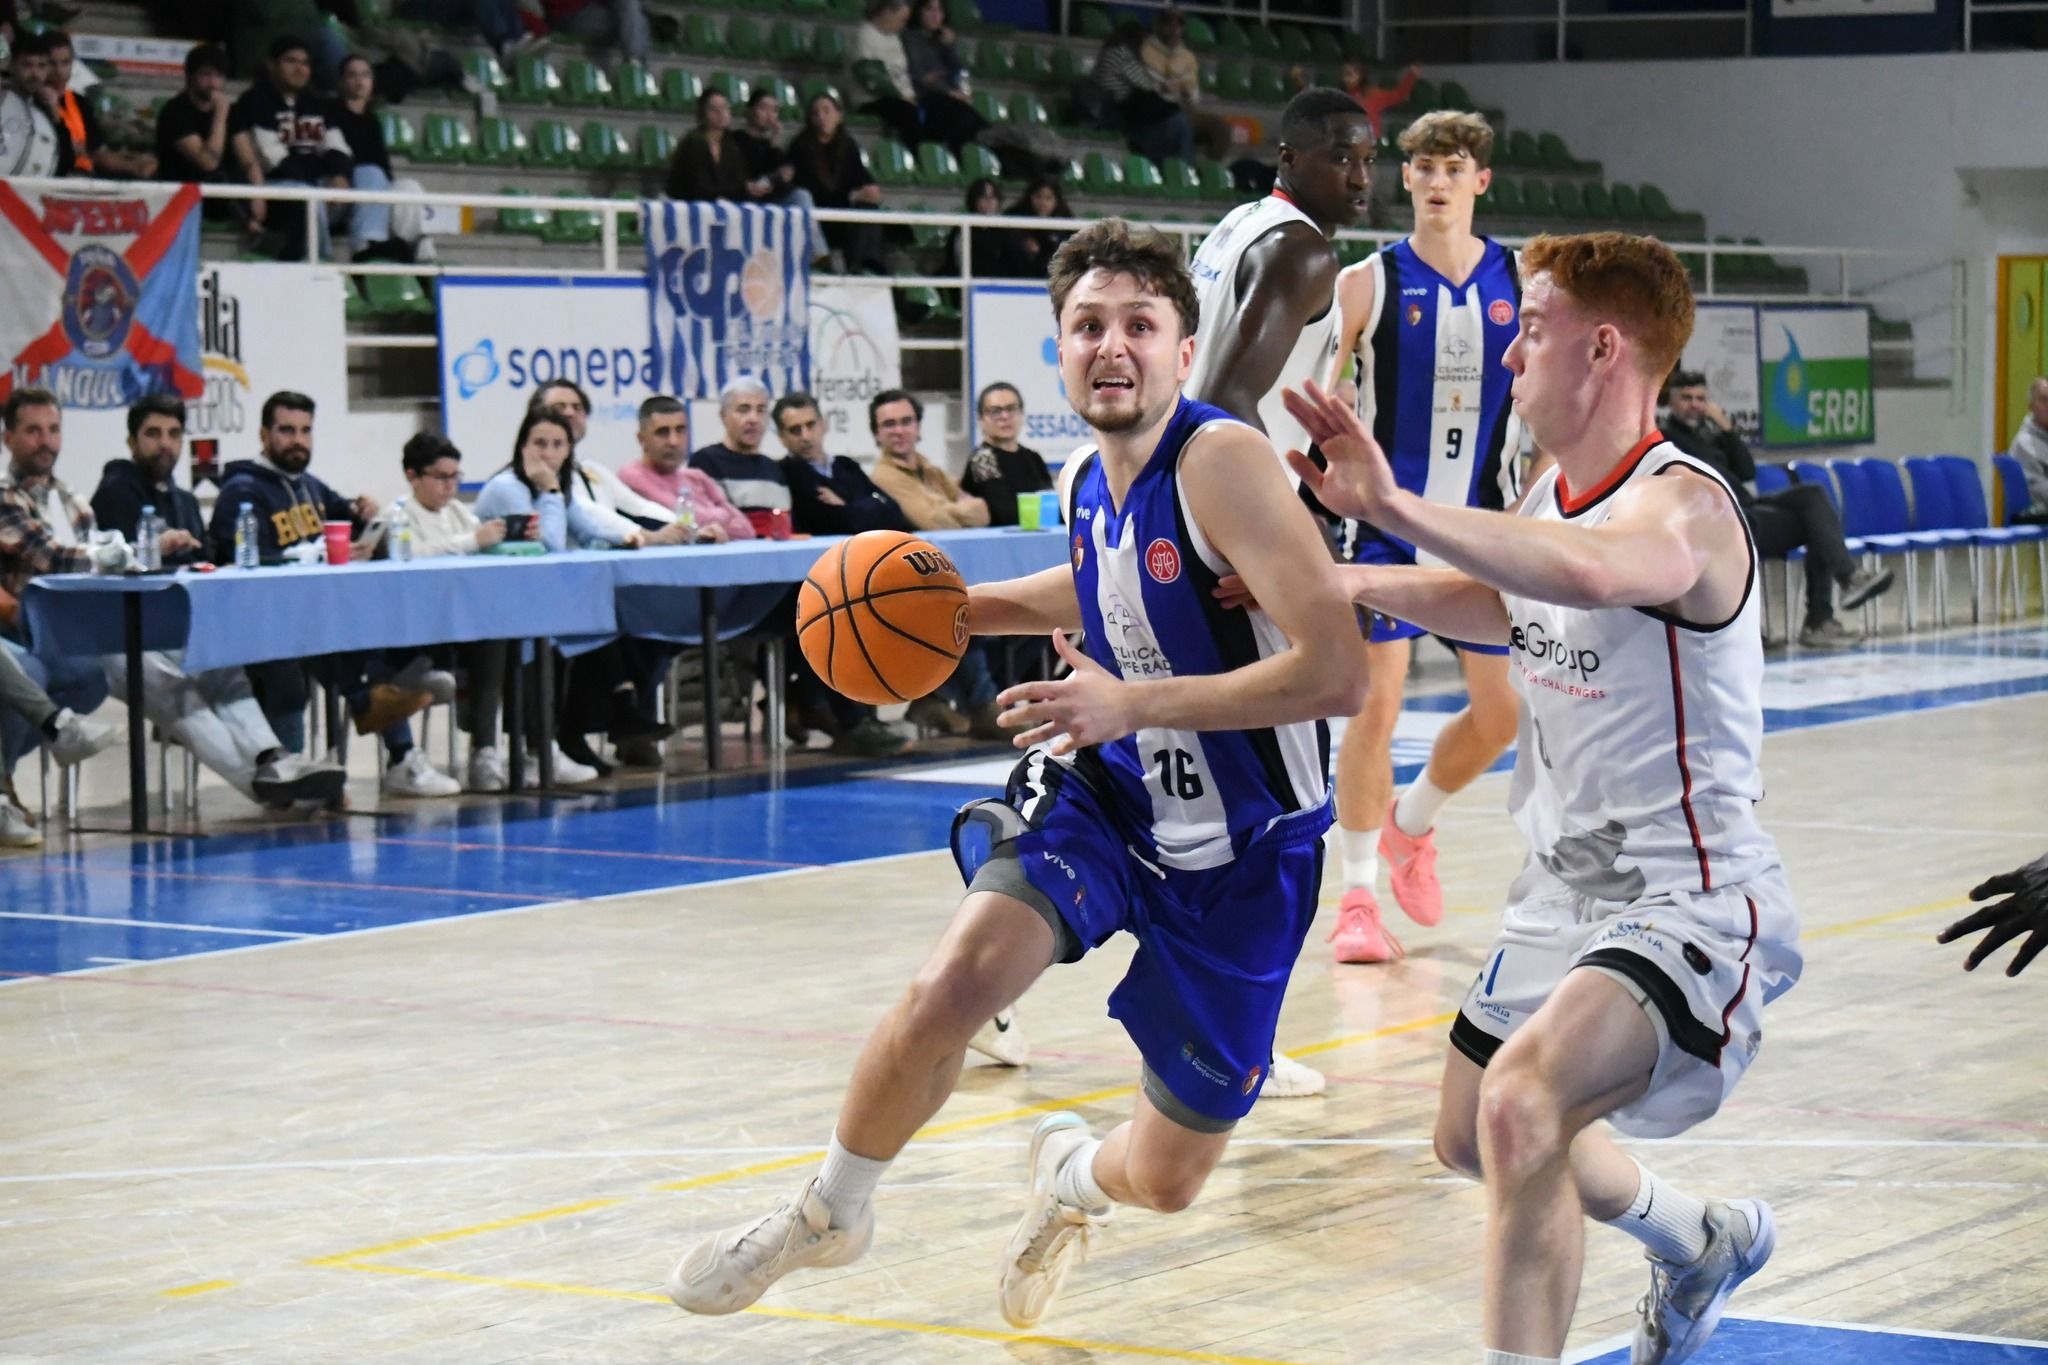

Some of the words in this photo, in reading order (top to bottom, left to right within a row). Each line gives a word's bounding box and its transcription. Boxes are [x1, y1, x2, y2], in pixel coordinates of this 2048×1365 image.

[1402, 287, 1428, 296] vive
[508, 346, 653, 397] sonepa
[1807, 389, 1868, 436] ERBI
[1446, 428, 1463, 459] 9
[1541, 678, 1606, 699] CHALLENGES
[1153, 748, 1204, 801] 16
[1043, 851, 1076, 880] vive
